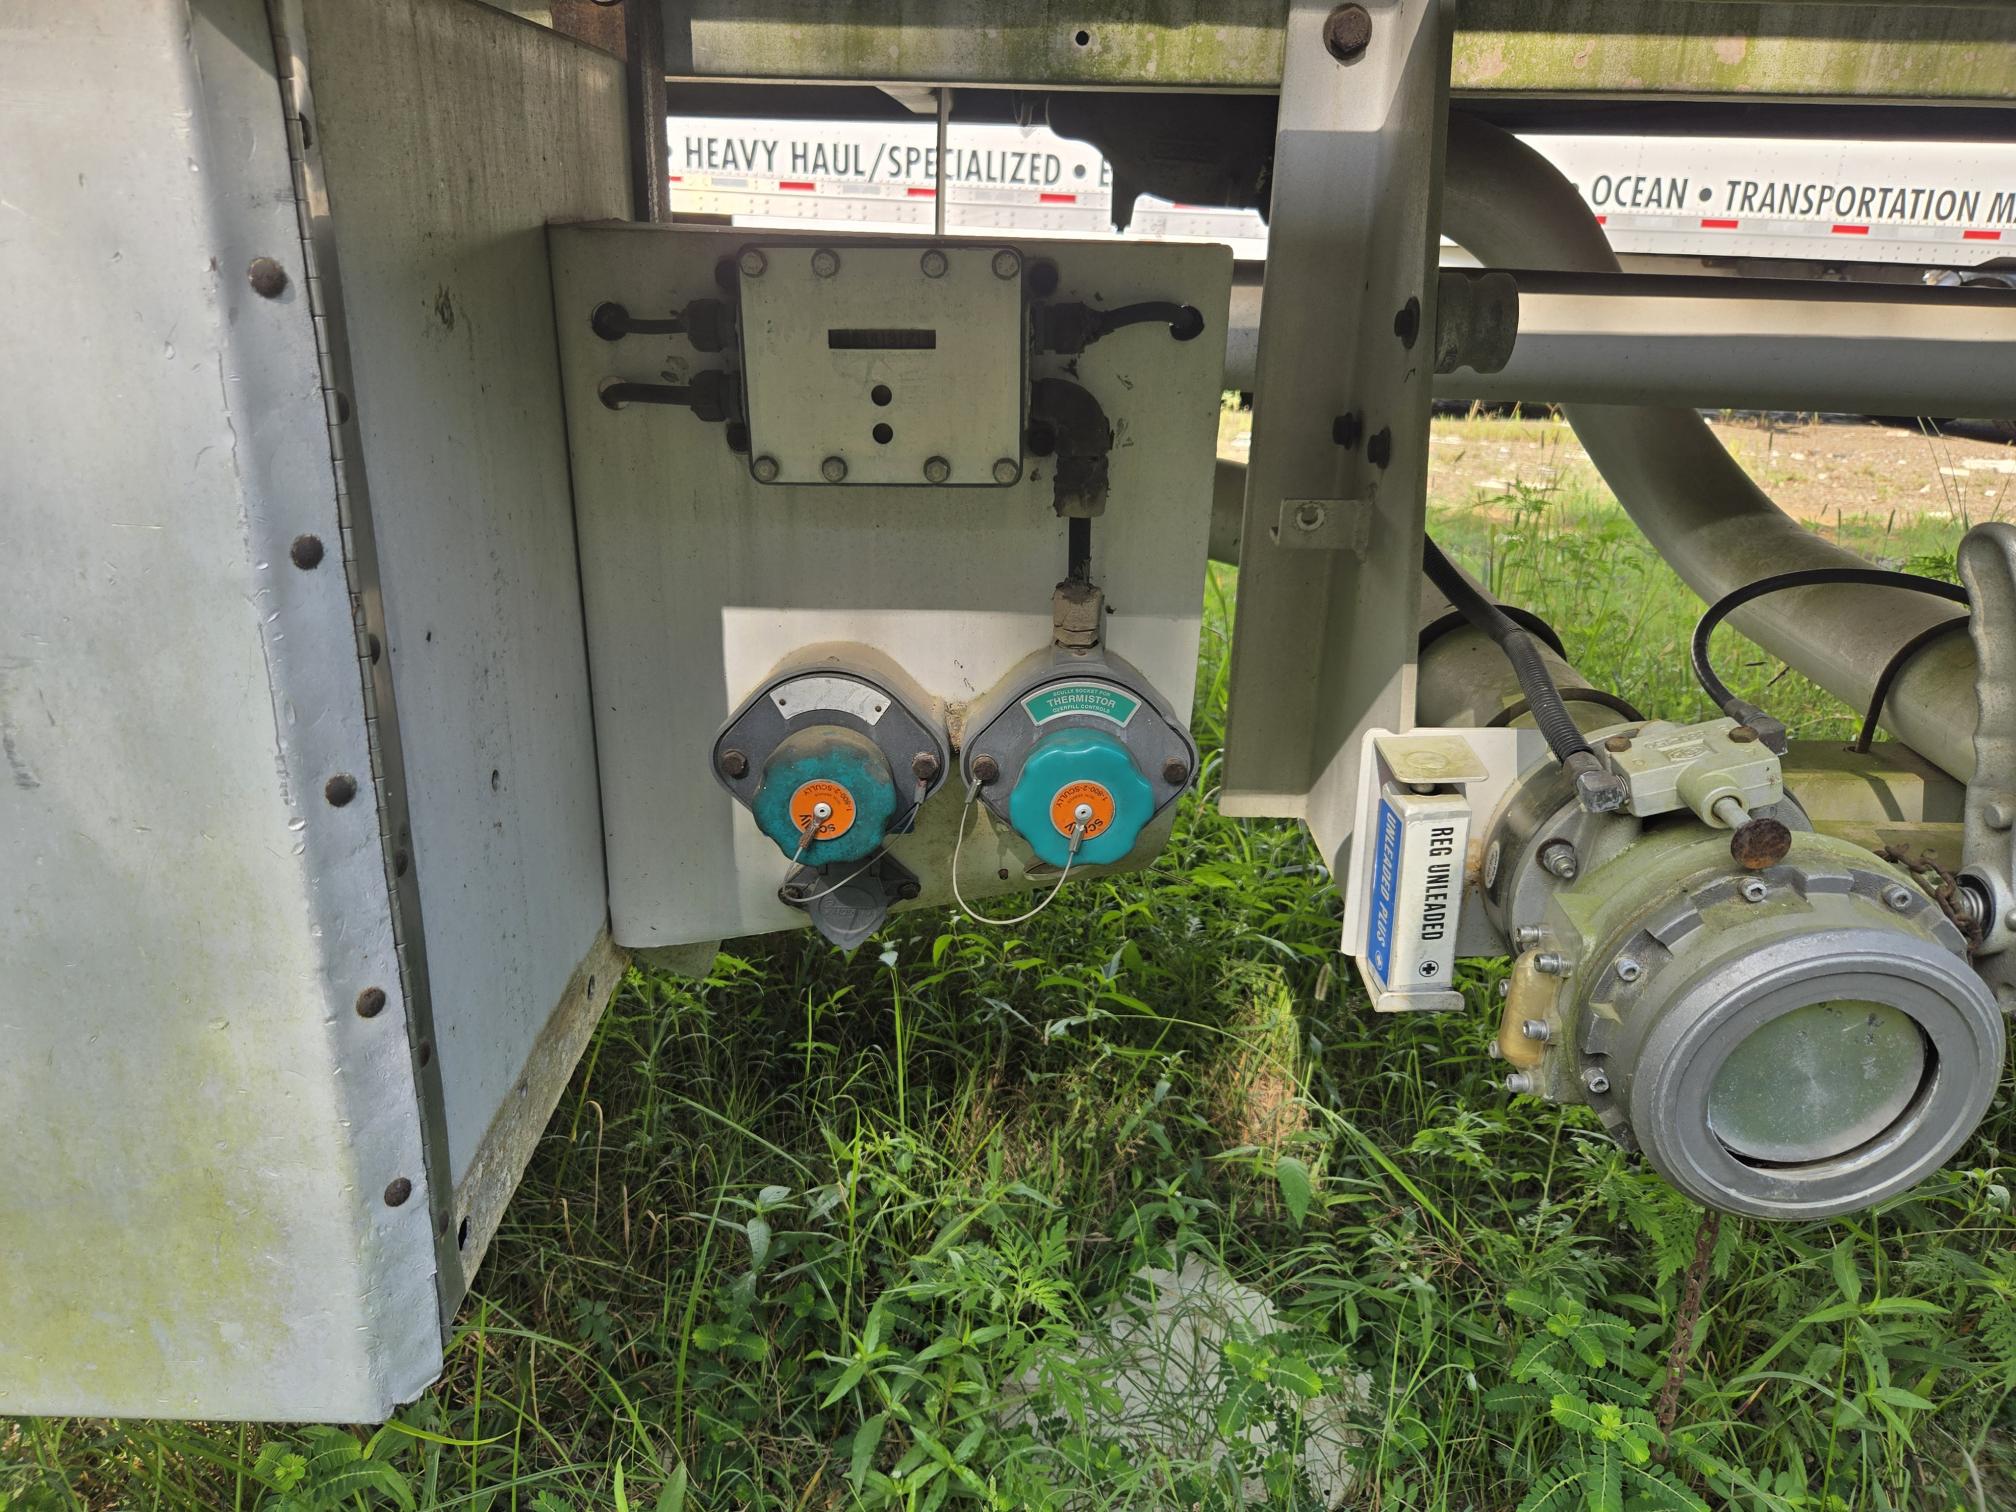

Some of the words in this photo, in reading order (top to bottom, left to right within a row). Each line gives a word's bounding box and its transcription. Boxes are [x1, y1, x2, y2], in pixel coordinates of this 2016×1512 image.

[685, 136, 779, 173] HEAVY
[1592, 174, 1689, 209] OCEAN
[1726, 180, 1981, 222] TRANSPORTATION
[1046, 694, 1117, 709] THERMISTOR
[1075, 687, 1098, 695] SOCKET
[1080, 704, 1111, 714] CONTROLS
[1379, 811, 1397, 902] UNLEADED
[1429, 826, 1454, 857] REG
[1421, 863, 1451, 941] UNLEADED
[1376, 900, 1389, 948] PLUS
